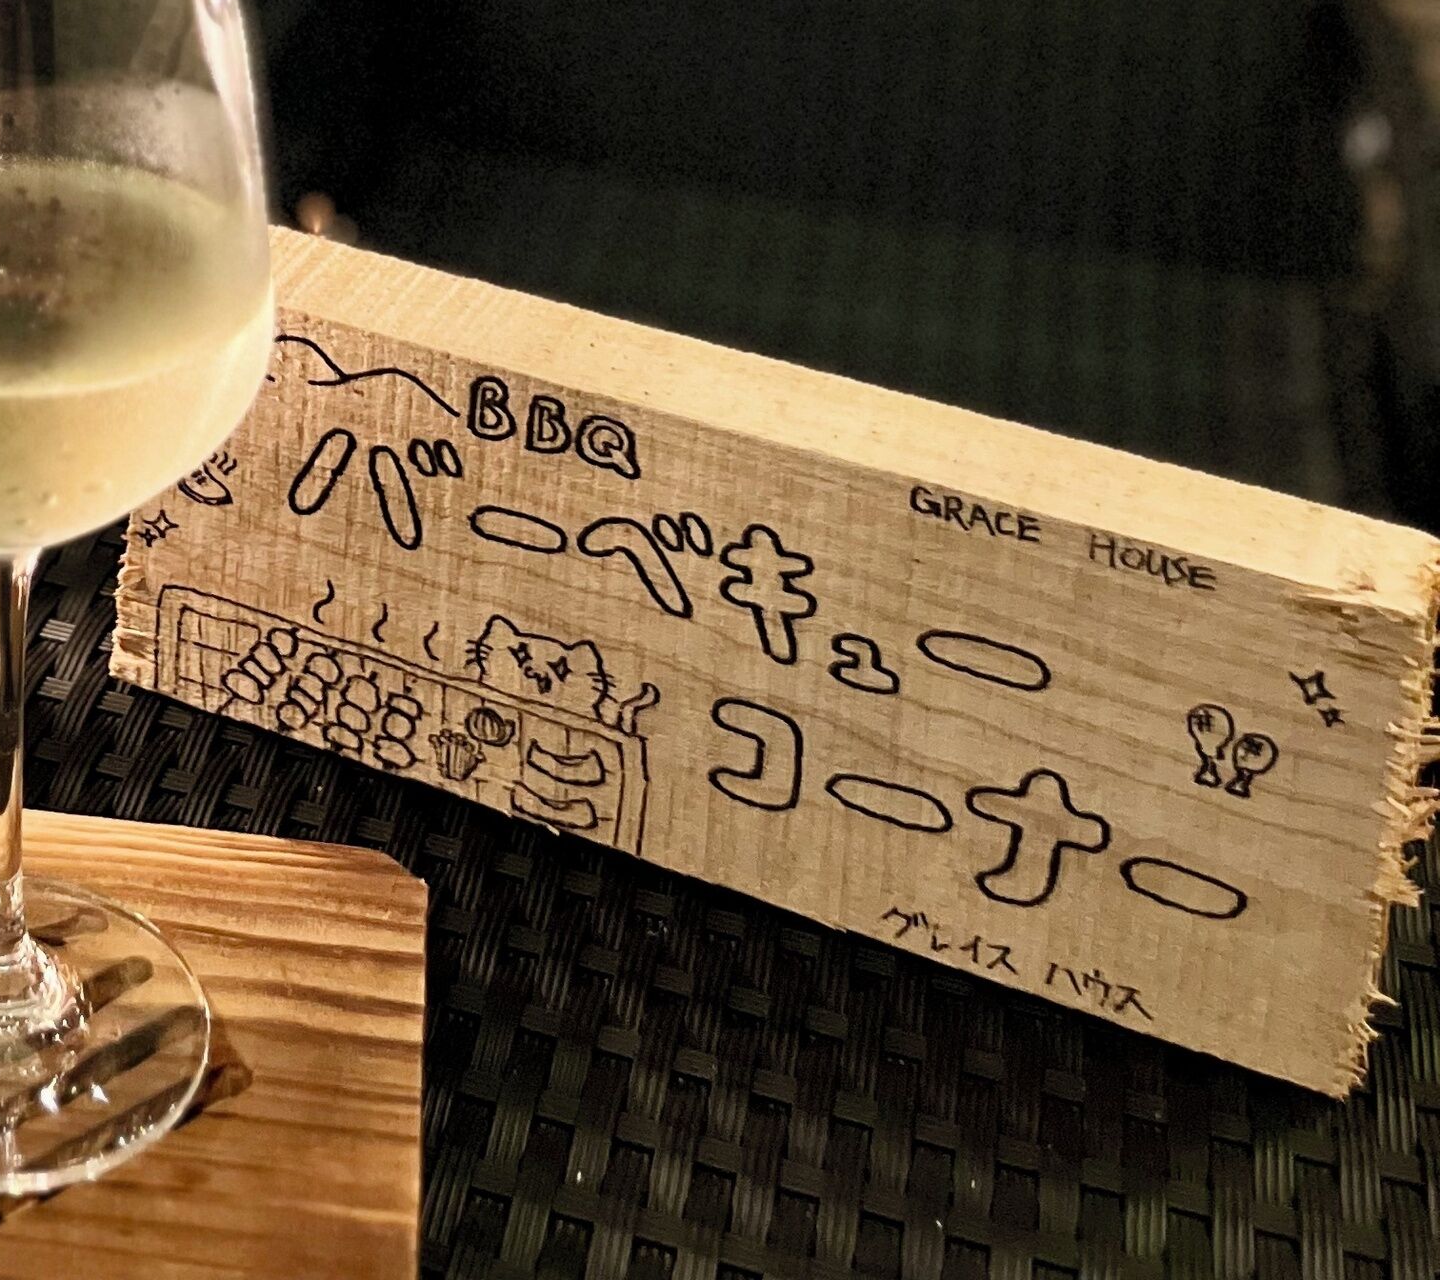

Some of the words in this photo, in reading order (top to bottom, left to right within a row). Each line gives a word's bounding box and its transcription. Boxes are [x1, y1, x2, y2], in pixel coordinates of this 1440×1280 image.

[468, 376, 640, 480] BBQ
[288, 428, 1051, 694] バーベキュー
[909, 485, 1041, 542] GRACE
[1089, 533, 1217, 591] HOUSE
[709, 697, 1248, 919] コーナー
[882, 905, 1020, 976] グレイス
[1045, 962, 1155, 1020] ハウス
